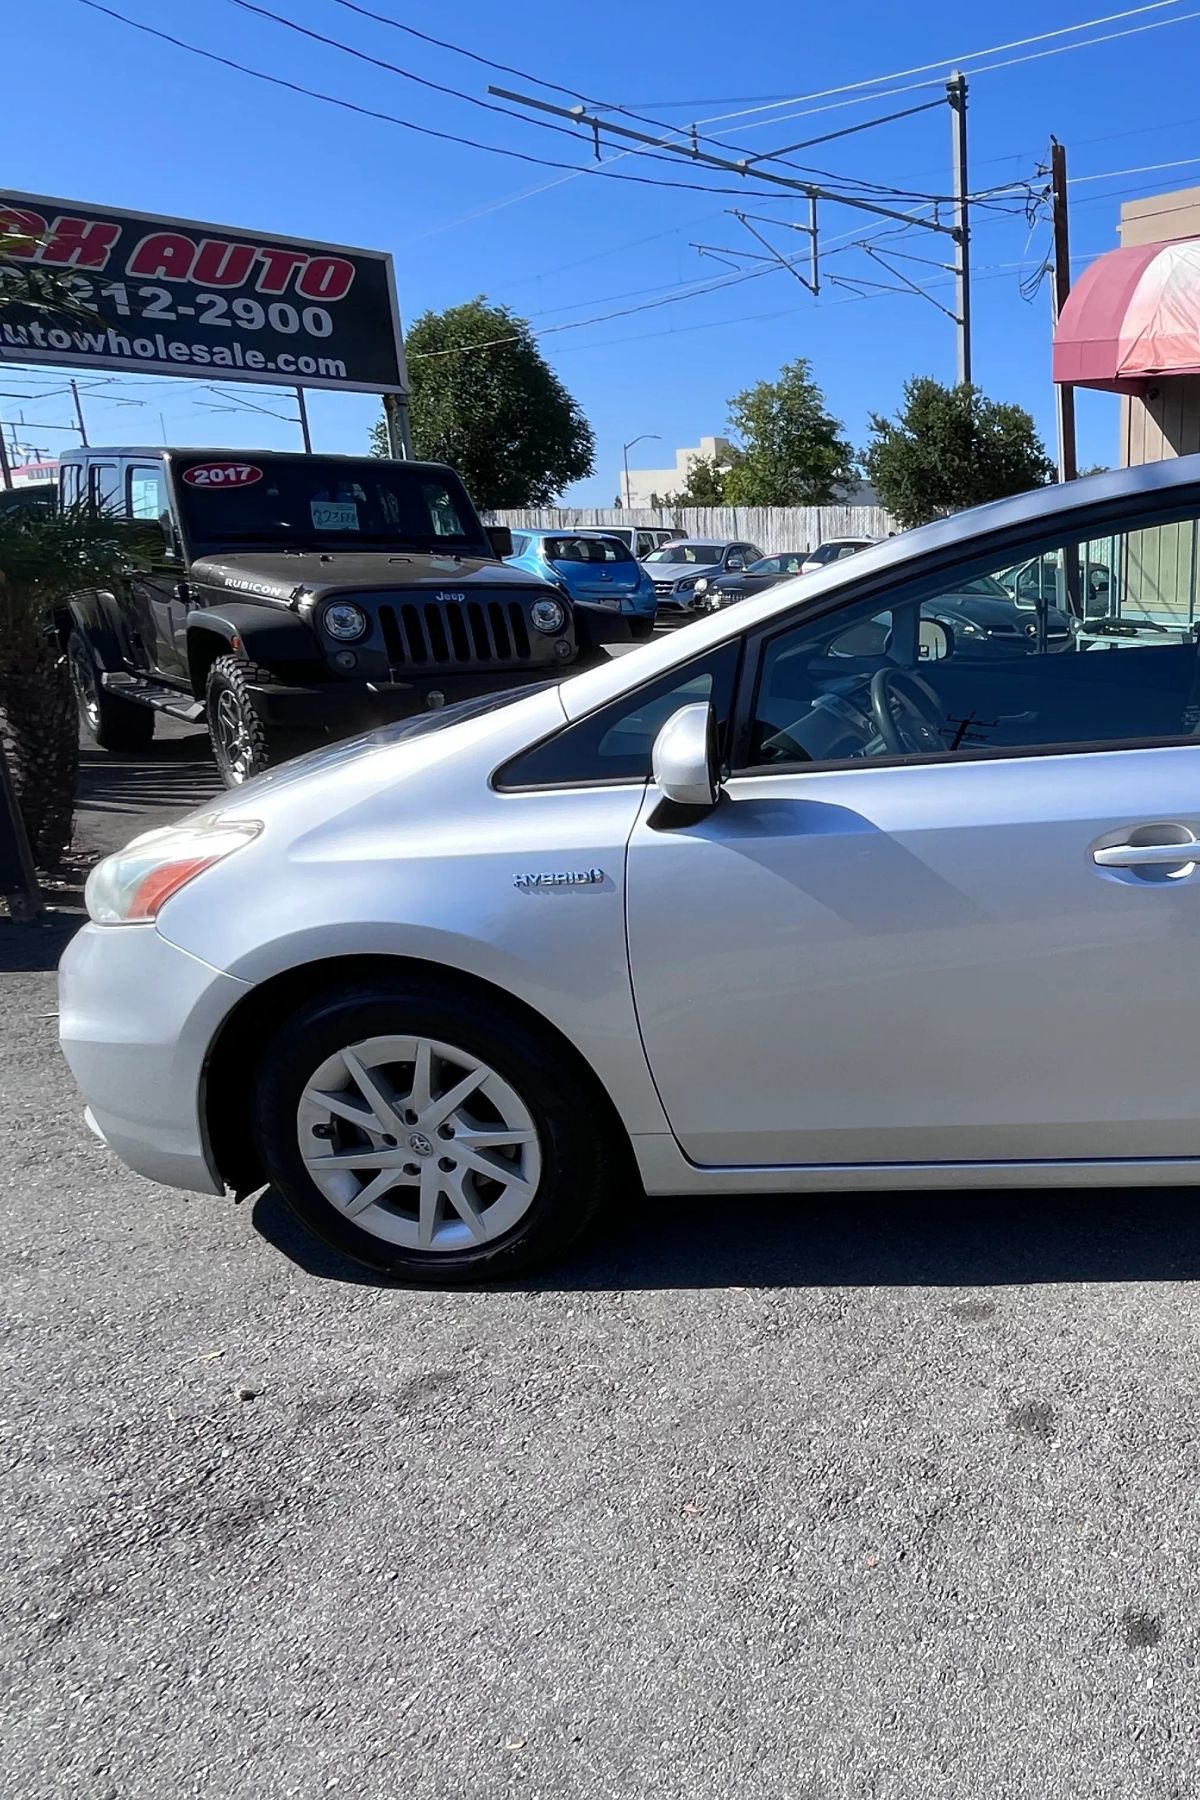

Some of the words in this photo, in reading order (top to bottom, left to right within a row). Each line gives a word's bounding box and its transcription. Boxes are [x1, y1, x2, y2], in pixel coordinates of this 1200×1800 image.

[125, 233, 356, 301] AUTO
[0, 320, 347, 378] utowholesale.com
[194, 467, 251, 484] 2017
[224, 577, 282, 596] RUBICON
[435, 591, 466, 603] Jeep
[513, 870, 590, 888] HYBRID
